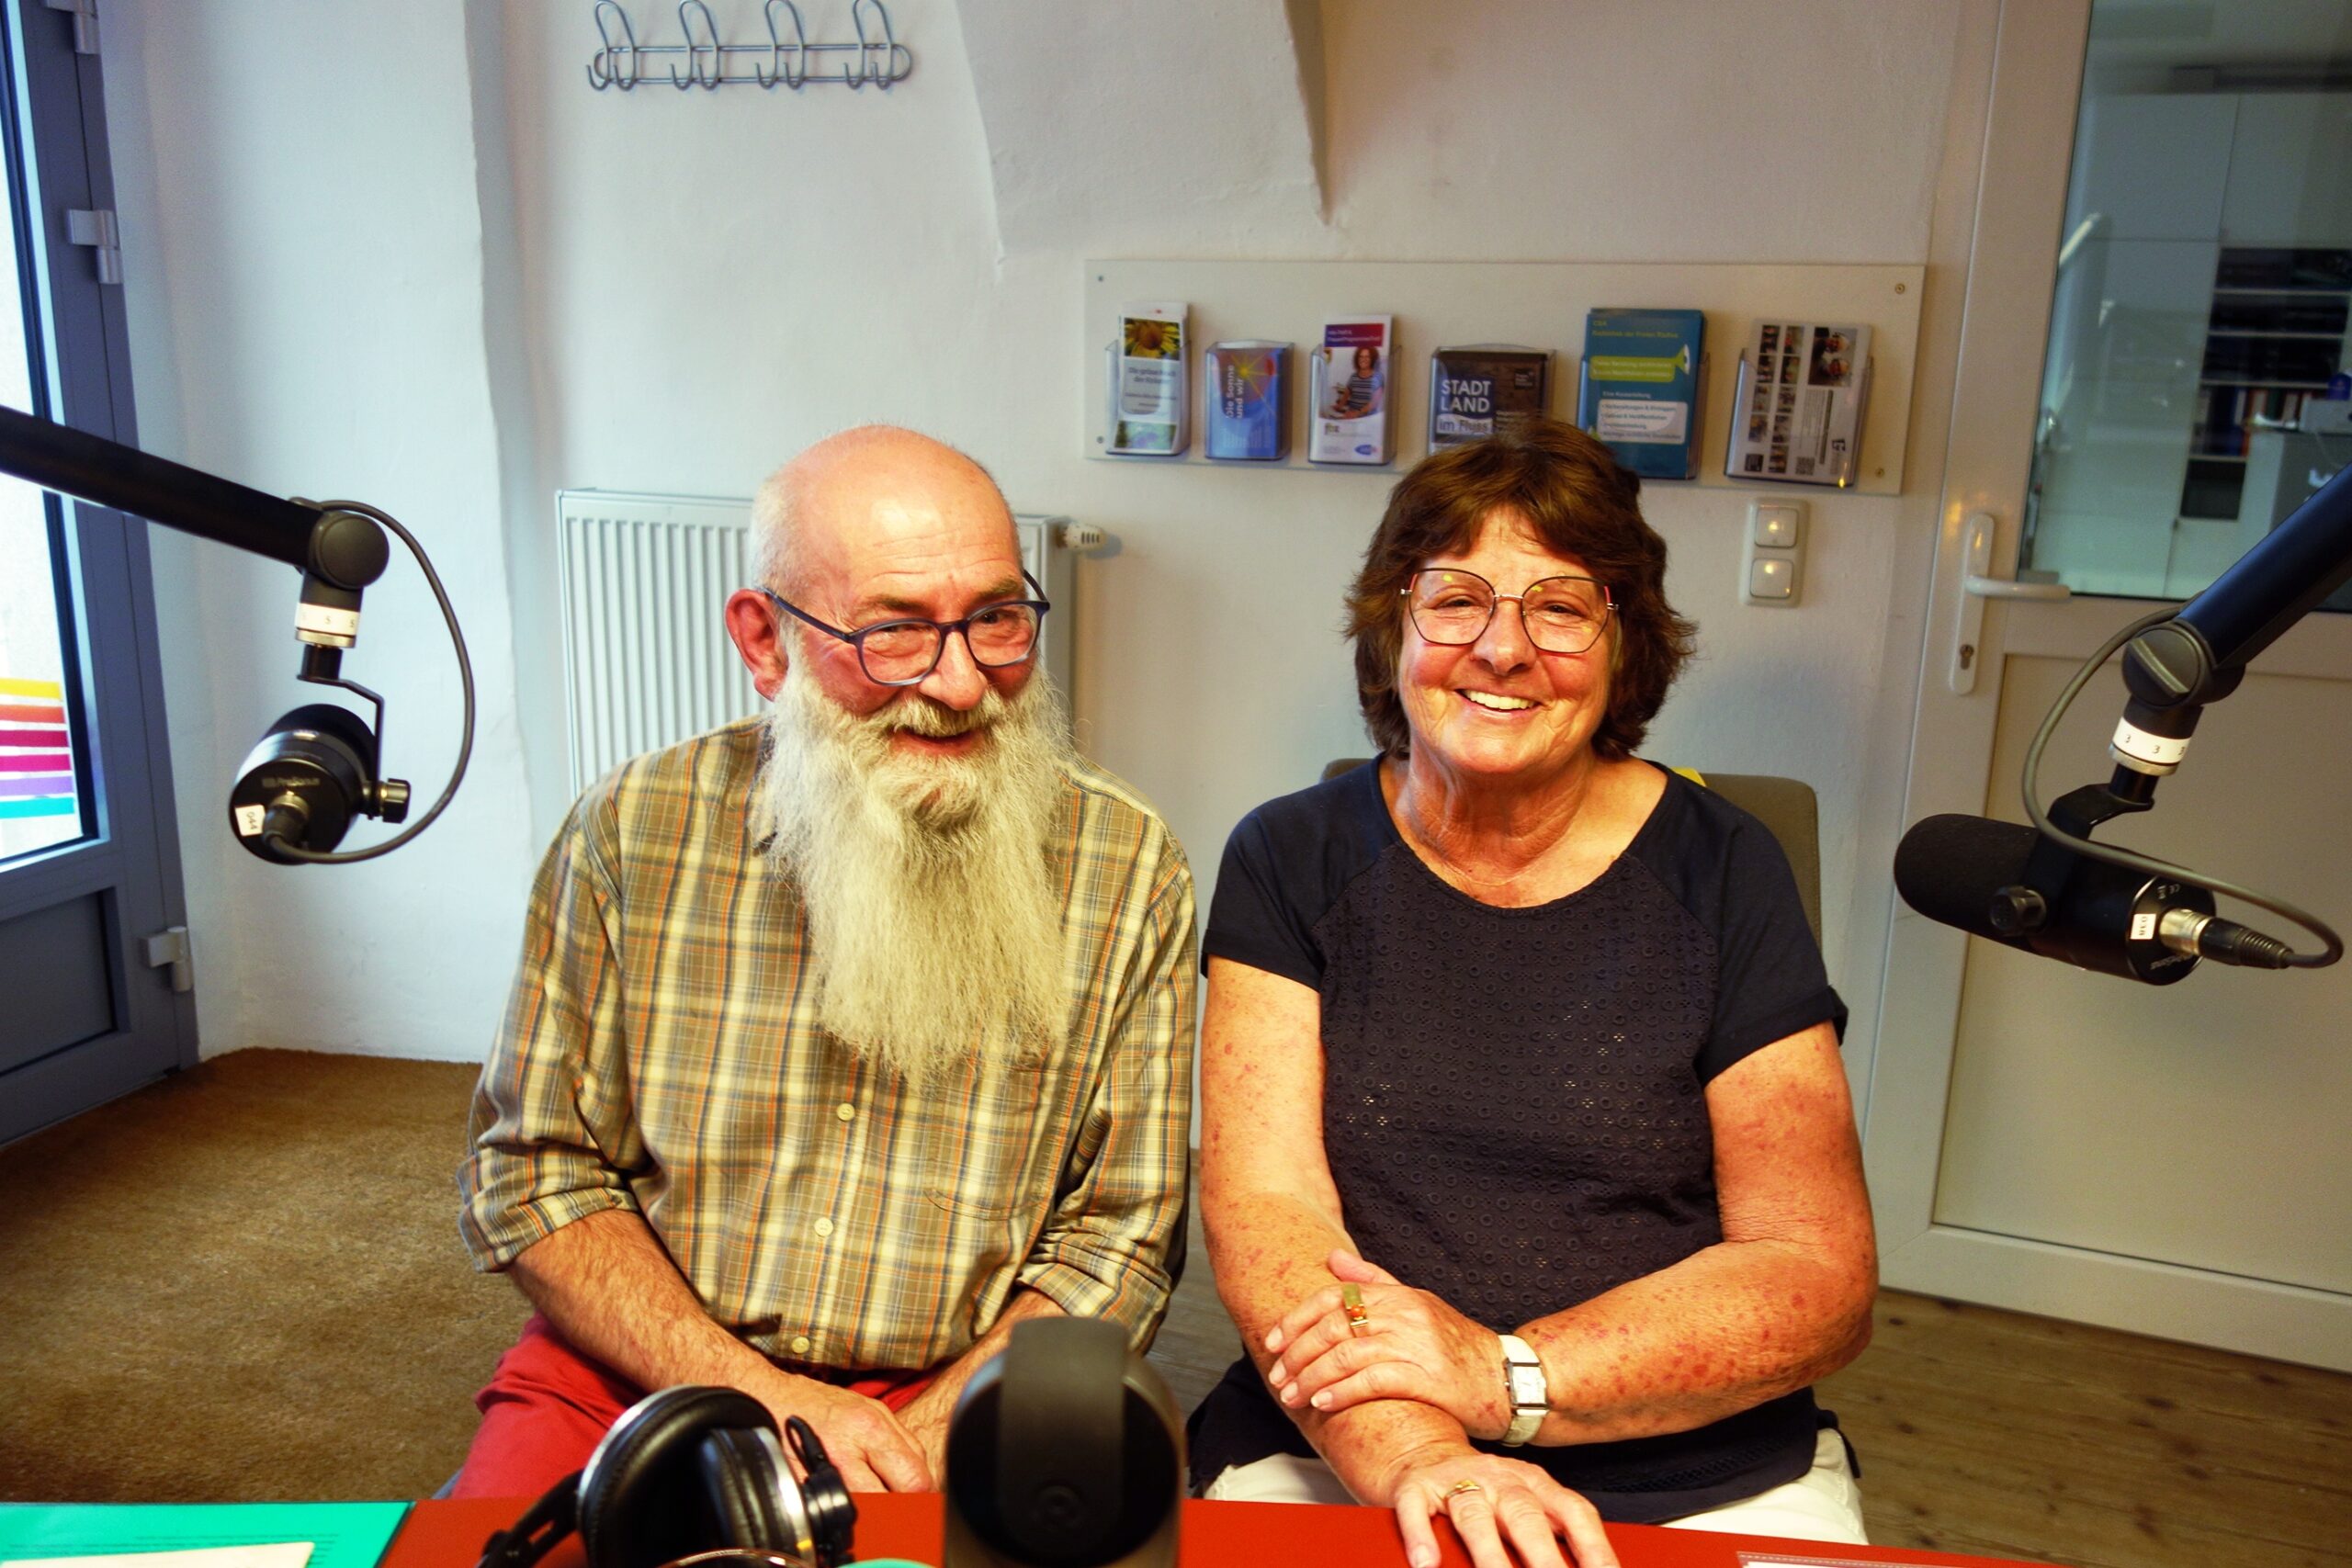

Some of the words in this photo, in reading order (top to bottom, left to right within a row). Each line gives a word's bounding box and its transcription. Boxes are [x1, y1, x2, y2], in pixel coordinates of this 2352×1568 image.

[1226, 365, 1235, 398] Sonne
[1234, 378, 1243, 394] wir
[1442, 379, 1492, 396] STADT
[1225, 400, 1234, 418] Die
[1441, 397, 1490, 412] LAND
[1439, 419, 1454, 432] im
[1459, 419, 1487, 432] Fluss
[2124, 734, 2132, 744] 3
[2152, 744, 2161, 754] 3
